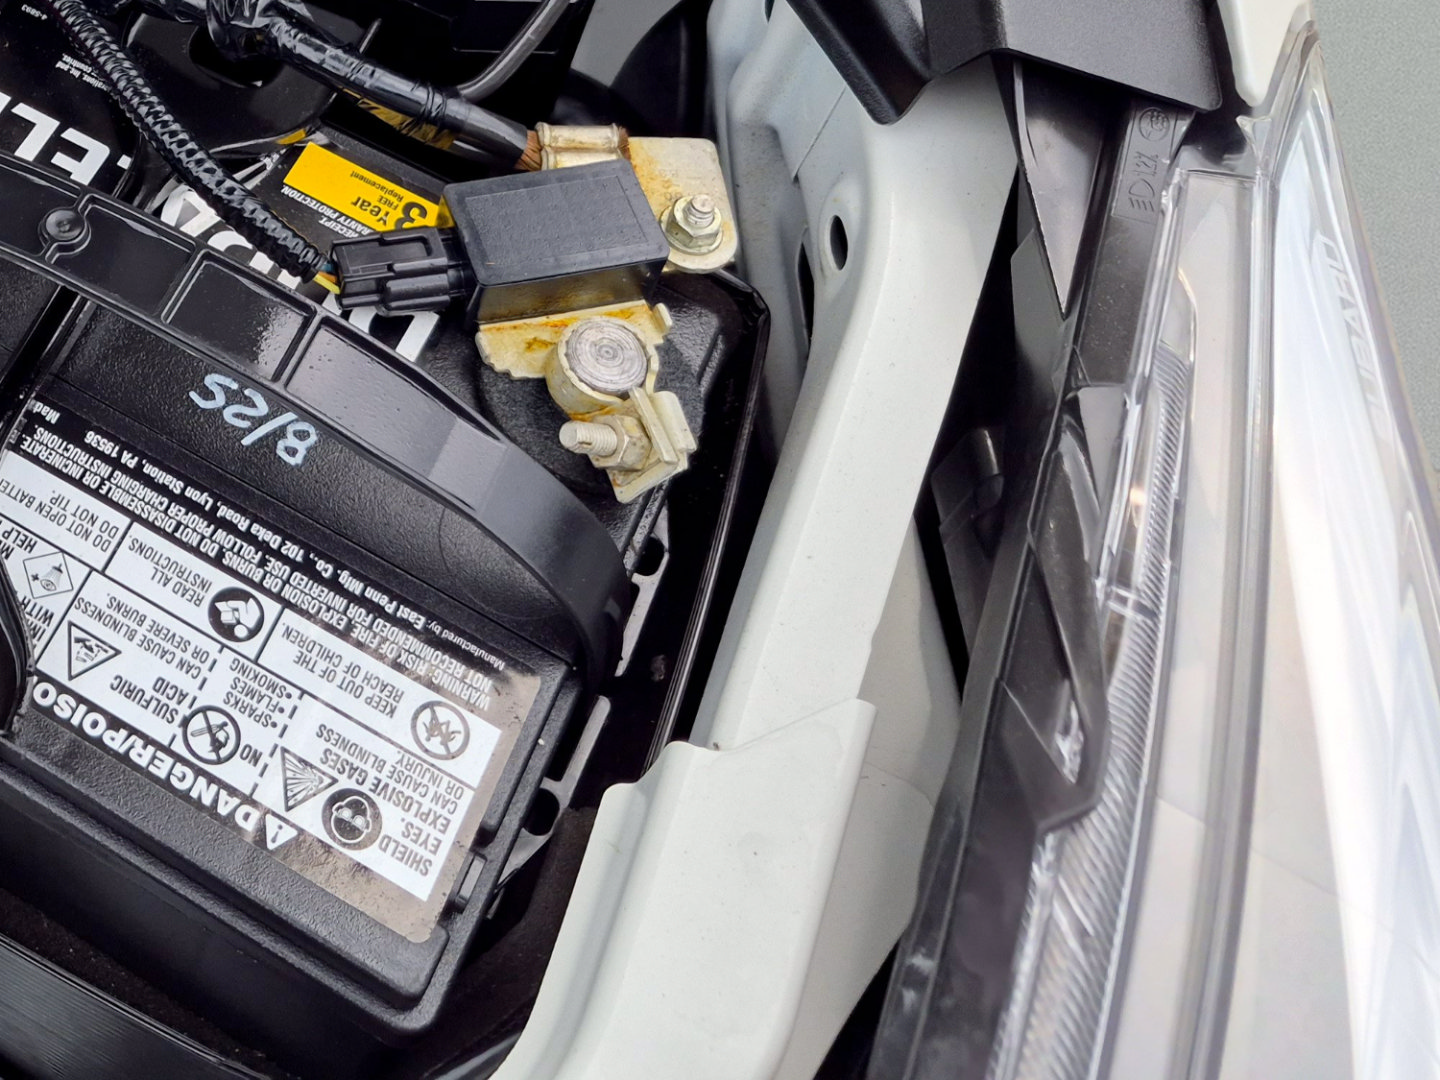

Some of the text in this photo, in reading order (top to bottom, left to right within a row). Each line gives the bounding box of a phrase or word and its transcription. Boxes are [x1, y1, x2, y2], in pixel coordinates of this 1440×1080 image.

[280, 179, 339, 224] PROTECTION.
[349, 170, 404, 206] Replacement
[376, 194, 399, 210] FREE
[350, 195, 390, 226] Year
[189, 373, 317, 465] 8/25
[84, 430, 119, 457] 19536
[120, 450, 138, 468] PA
[141, 459, 184, 494] Station,
[34, 500, 67, 526] OPEN
[48, 490, 119, 539] DO NOT TIP.
[184, 485, 213, 511] Lyon
[65, 519, 93, 541] NOT
[216, 501, 250, 531] Road,
[1, 526, 37, 553] HELP
[91, 533, 111, 552] DO
[249, 522, 282, 549] Deka
[280, 540, 304, 561] 102
[20, 434, 491, 711] WARNING: RISK OF FIRE, EXPLOSION OR BURNS. DO NOT DISASSEMBLE OR INCINERATE.
[29, 425, 492, 697] NOT RECOMMENDED FOR INVERTED USE. FOLLOW PROPER CHARGING INSTRUCTIONS.
[128, 535, 212, 593] INSTRUCTIONS.
[150, 566, 205, 607] READ ALL
[336, 569, 364, 595] Mfg.
[363, 586, 397, 614] Penn
[395, 604, 426, 630] East
[73, 596, 137, 642] BLINDNESS
[106, 593, 210, 664] OR SEVERE BURNS.
[420, 620, 442, 635] by:
[136, 633, 176, 664] CAUSE
[281, 622, 404, 704] REACH OF CHILDREN.
[440, 629, 505, 671] Manufactured
[175, 656, 201, 679] CAN
[292, 649, 397, 718] KEEP OUT OF THE
[109, 674, 178, 724] SULFURIC
[152, 676, 189, 705] ACID
[27, 677, 264, 833] DANGER/POISO
[239, 743, 262, 767] NO
[315, 723, 458, 815] CAN CAUSE BLINDNESS
[319, 747, 450, 834] EXPLOSIVE GASES
[394, 747, 466, 800] OR INJURY.
[400, 817, 442, 855] EYES.
[378, 834, 432, 876] SHIELD
